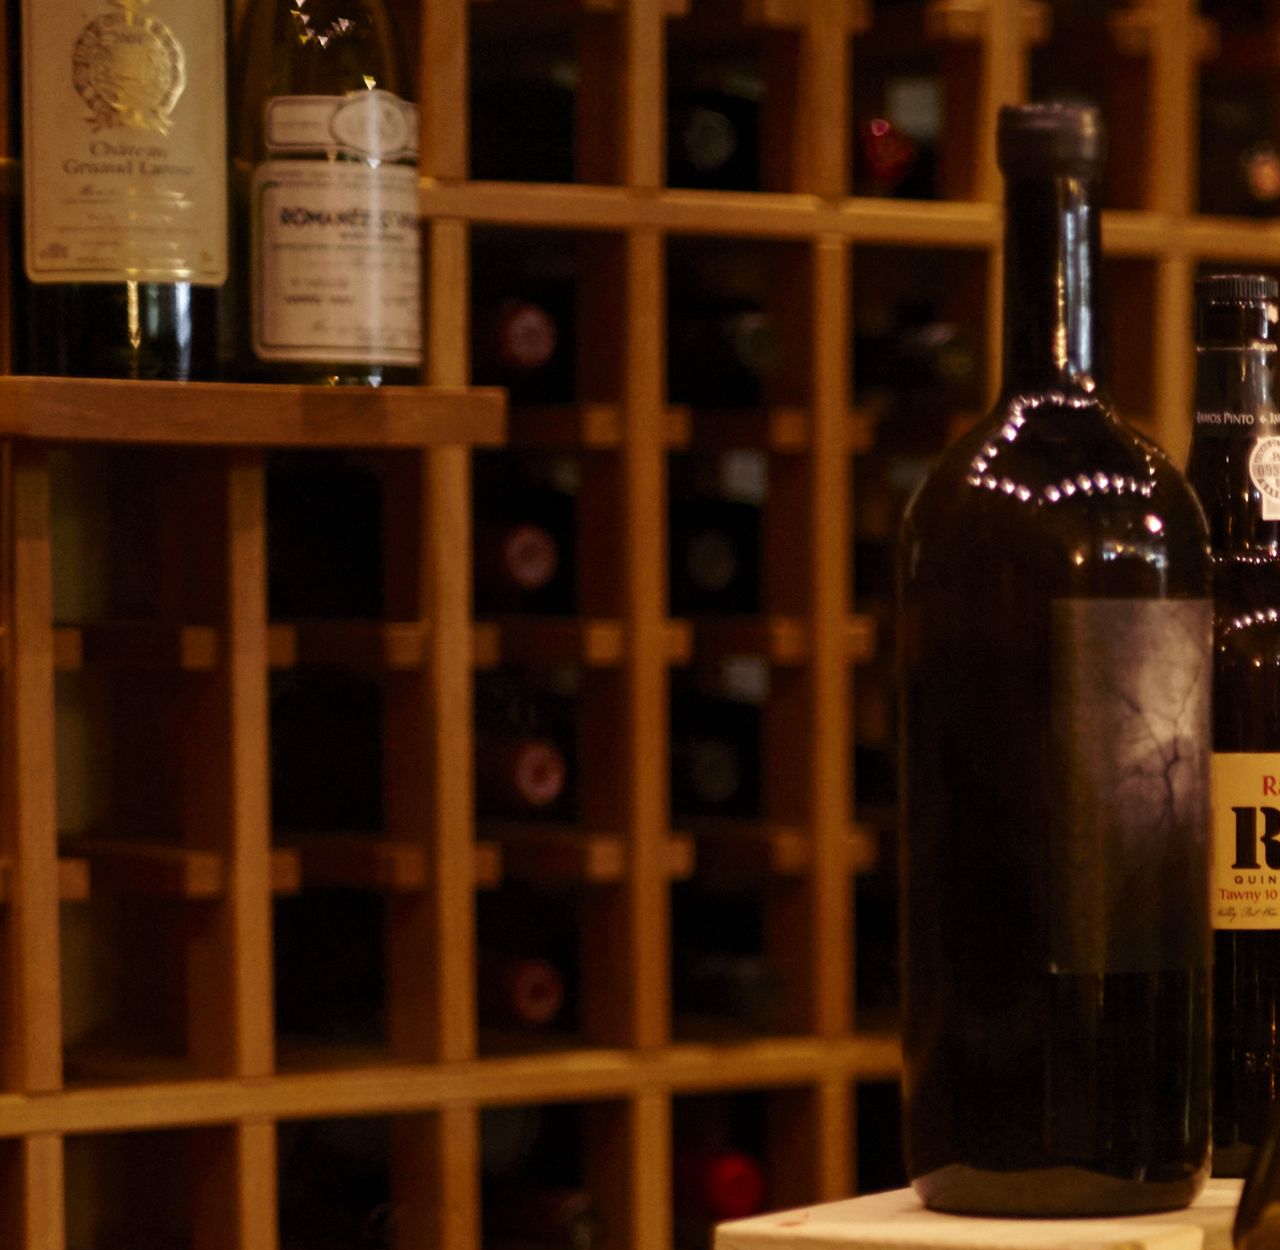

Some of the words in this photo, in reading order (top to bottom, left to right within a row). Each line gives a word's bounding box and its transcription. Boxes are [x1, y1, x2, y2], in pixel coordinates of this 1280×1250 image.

[1224, 412, 1254, 424] PINTO
[1219, 887, 1261, 904] Tawny
[1265, 888, 1278, 901] 10
